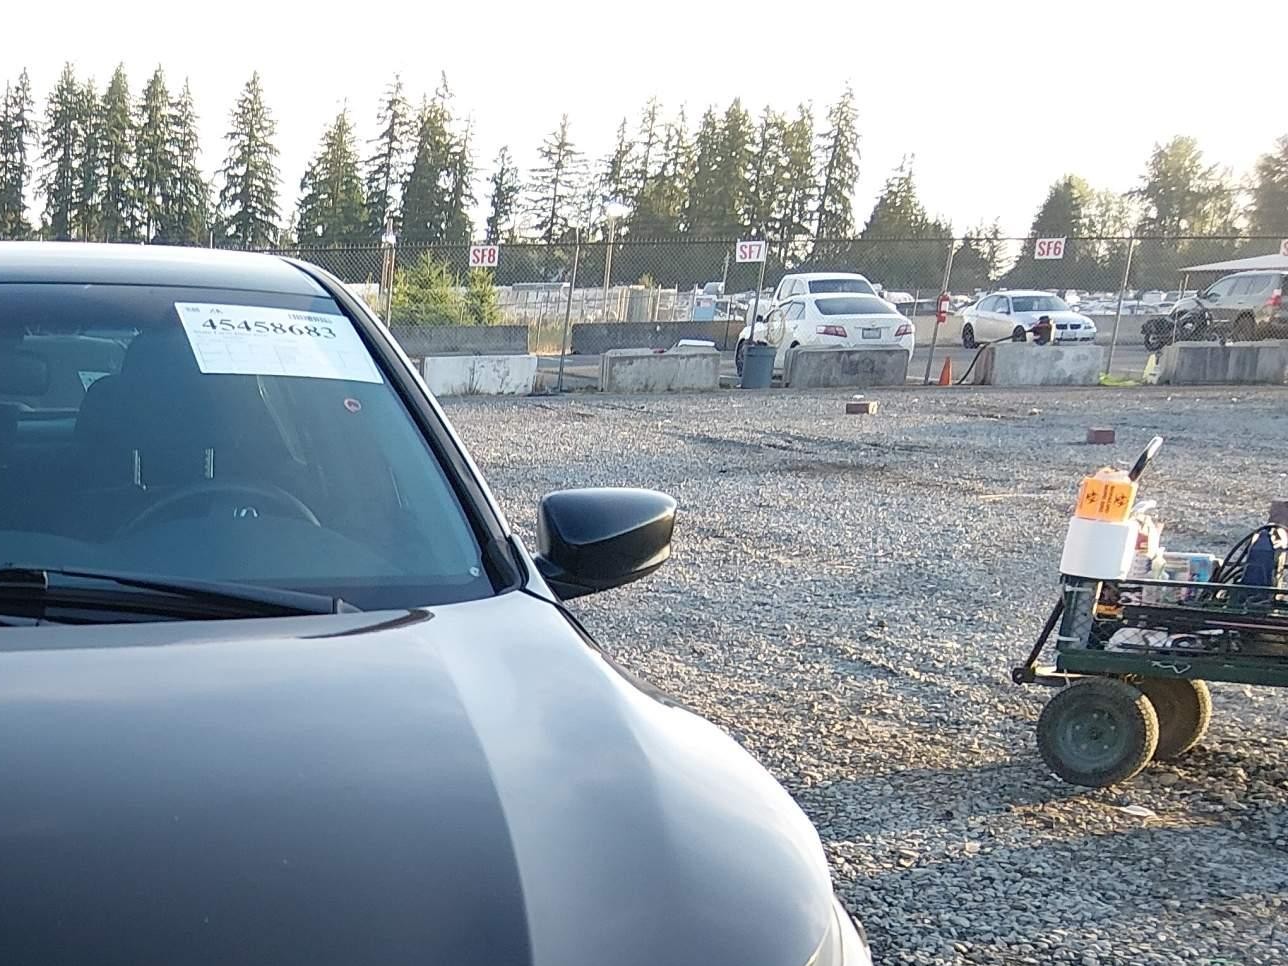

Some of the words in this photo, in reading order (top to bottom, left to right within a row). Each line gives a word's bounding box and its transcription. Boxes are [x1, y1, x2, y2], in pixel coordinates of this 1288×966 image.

[472, 248, 496, 264] SF8
[739, 244, 762, 260] SF7
[1037, 240, 1062, 256] SF6
[201, 318, 337, 339] 45458683
